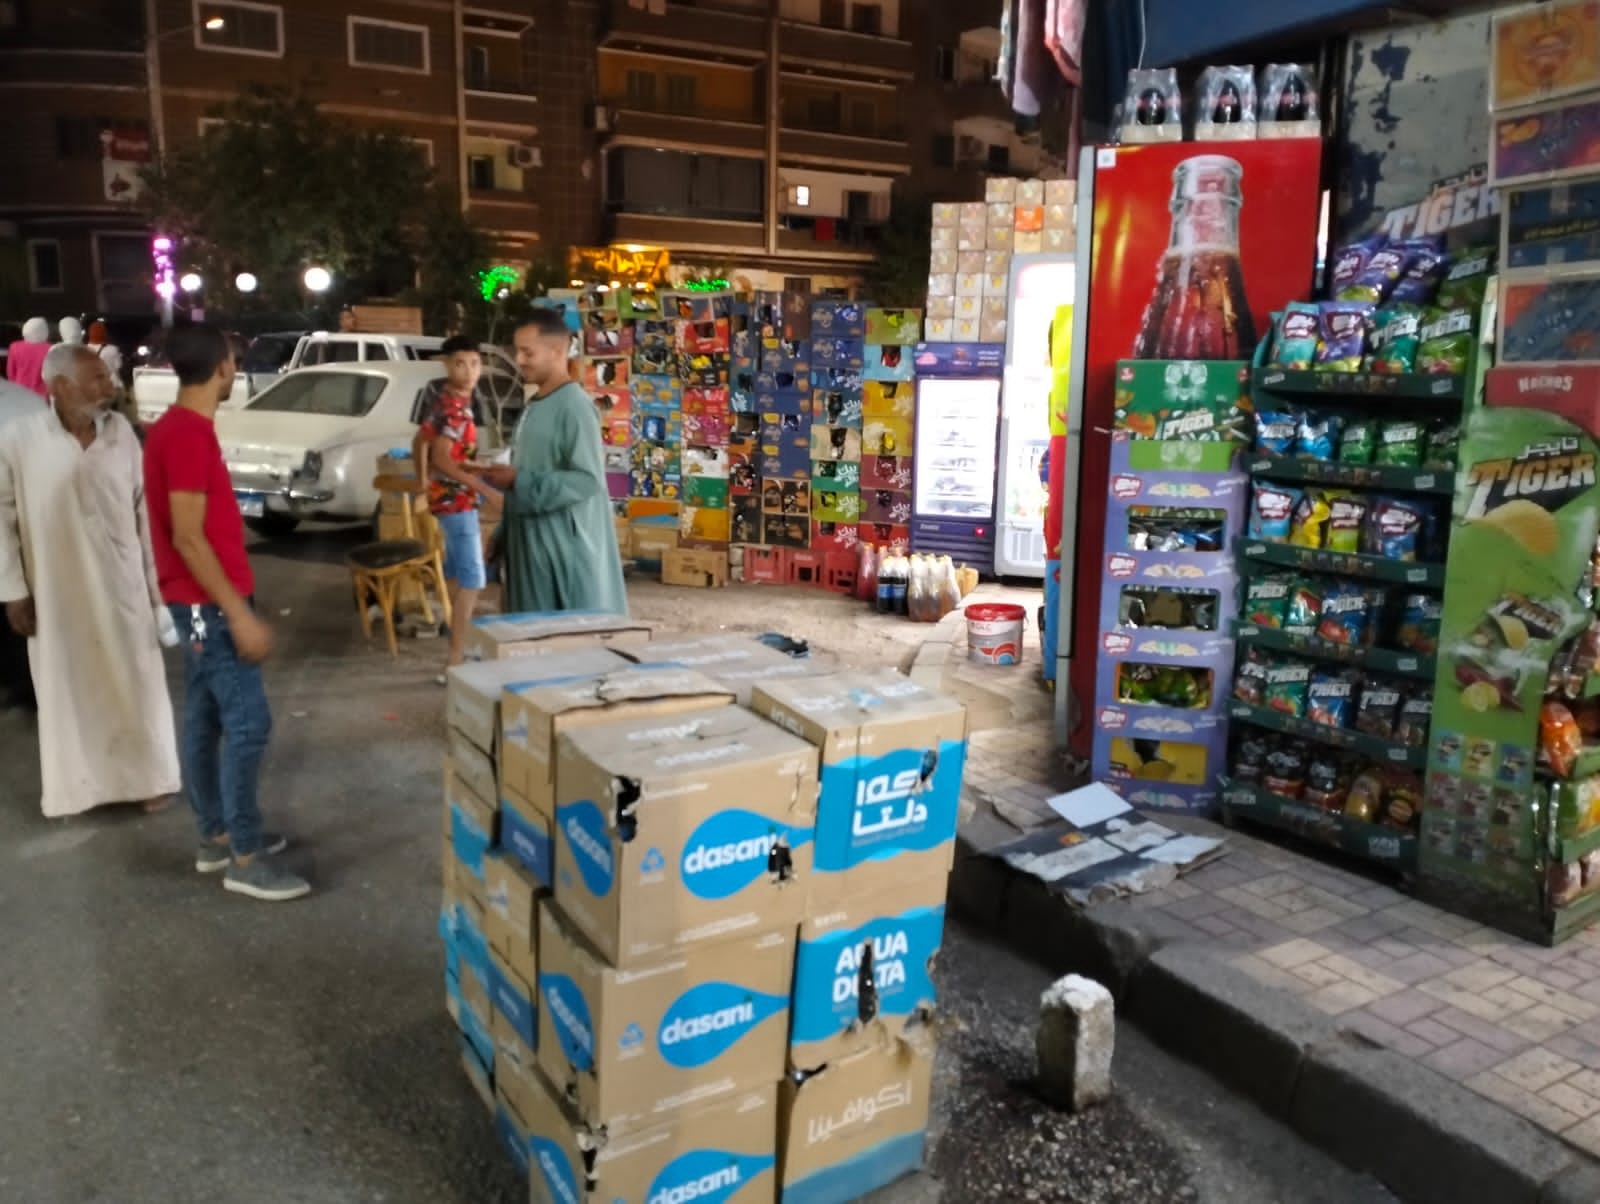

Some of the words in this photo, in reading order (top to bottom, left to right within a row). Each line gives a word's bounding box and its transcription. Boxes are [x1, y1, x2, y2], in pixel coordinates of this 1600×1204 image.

[1380, 183, 1500, 240] TIGER
[1162, 411, 1215, 438] TIGER
[1465, 453, 1596, 520] TIGER
[852, 799, 929, 837] دلتا
[660, 1000, 753, 1045] dasani
